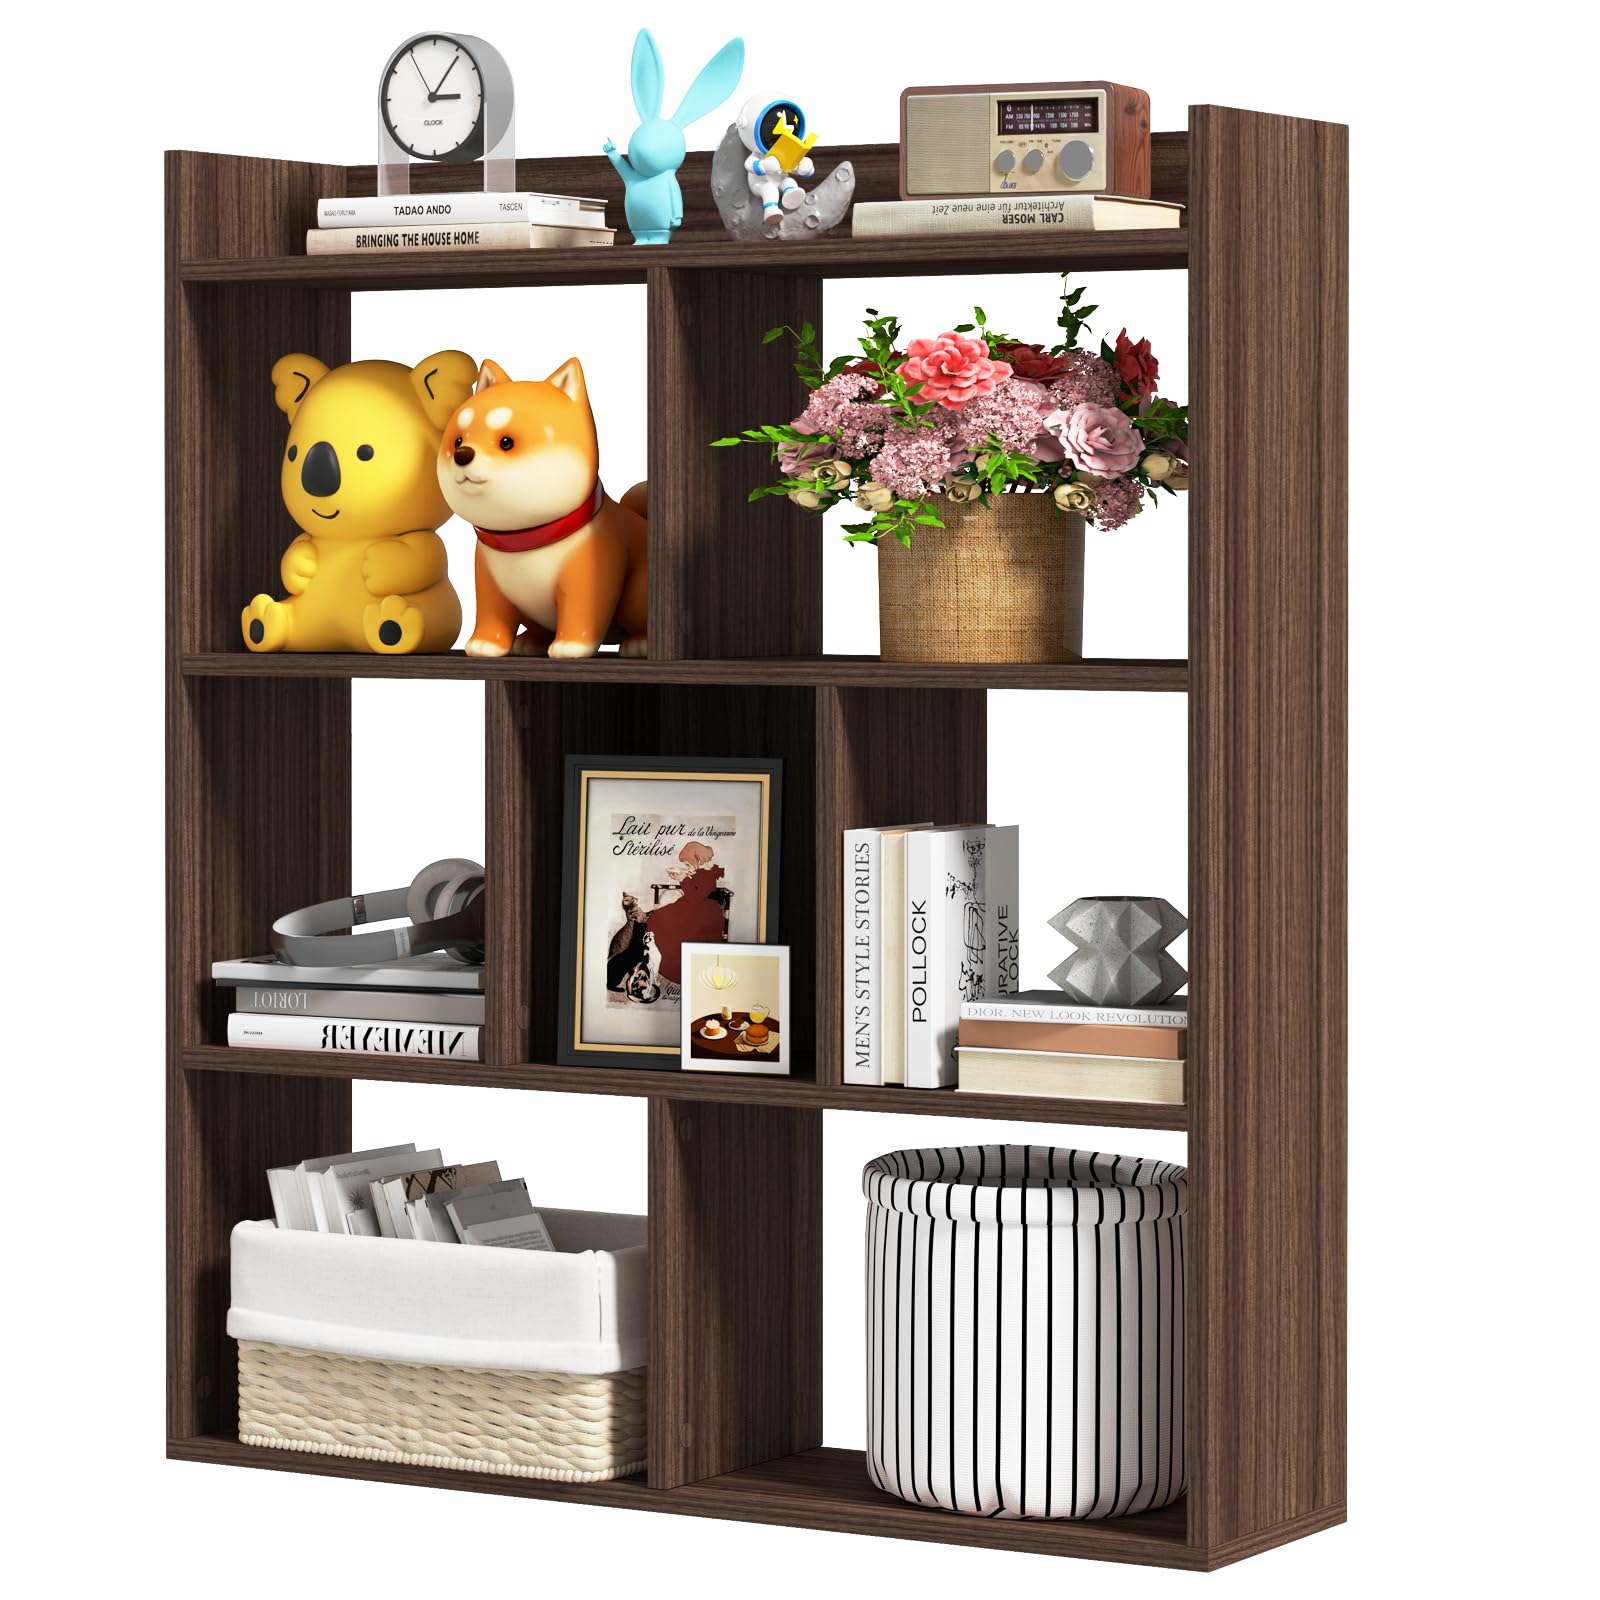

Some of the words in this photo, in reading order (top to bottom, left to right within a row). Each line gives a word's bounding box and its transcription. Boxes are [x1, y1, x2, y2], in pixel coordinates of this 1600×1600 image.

[393, 205, 424, 216] TADAO
[426, 204, 452, 215] ANDO
[499, 202, 523, 211] TASCEN
[932, 205, 950, 216] Zeit
[952, 204, 973, 213] neue
[976, 203, 996, 214] eine
[998, 203, 1011, 213] für
[1014, 201, 1065, 212] Architektur
[1002, 213, 1036, 224] MOSER
[1039, 212, 1064, 223] CARL
[356, 234, 399, 248] BRINGING
[402, 233, 419, 247] THE
[421, 232, 451, 246] HOUSE
[454, 231, 480, 245] HOME
[612, 815, 652, 836] Lait
[654, 823, 686, 840] pur
[687, 828, 696, 837] de
[697, 828, 704, 837] la
[612, 839, 676, 857] Stérilisé
[854, 842, 870, 930] STORIES
[855, 935, 870, 1000] STYLE
[911, 900, 927, 1023] POLLOCK
[1012, 1009, 1046, 1019] NEW
[1050, 1010, 1092, 1022] LOOK
[855, 1005, 870, 1068] MEN'S
